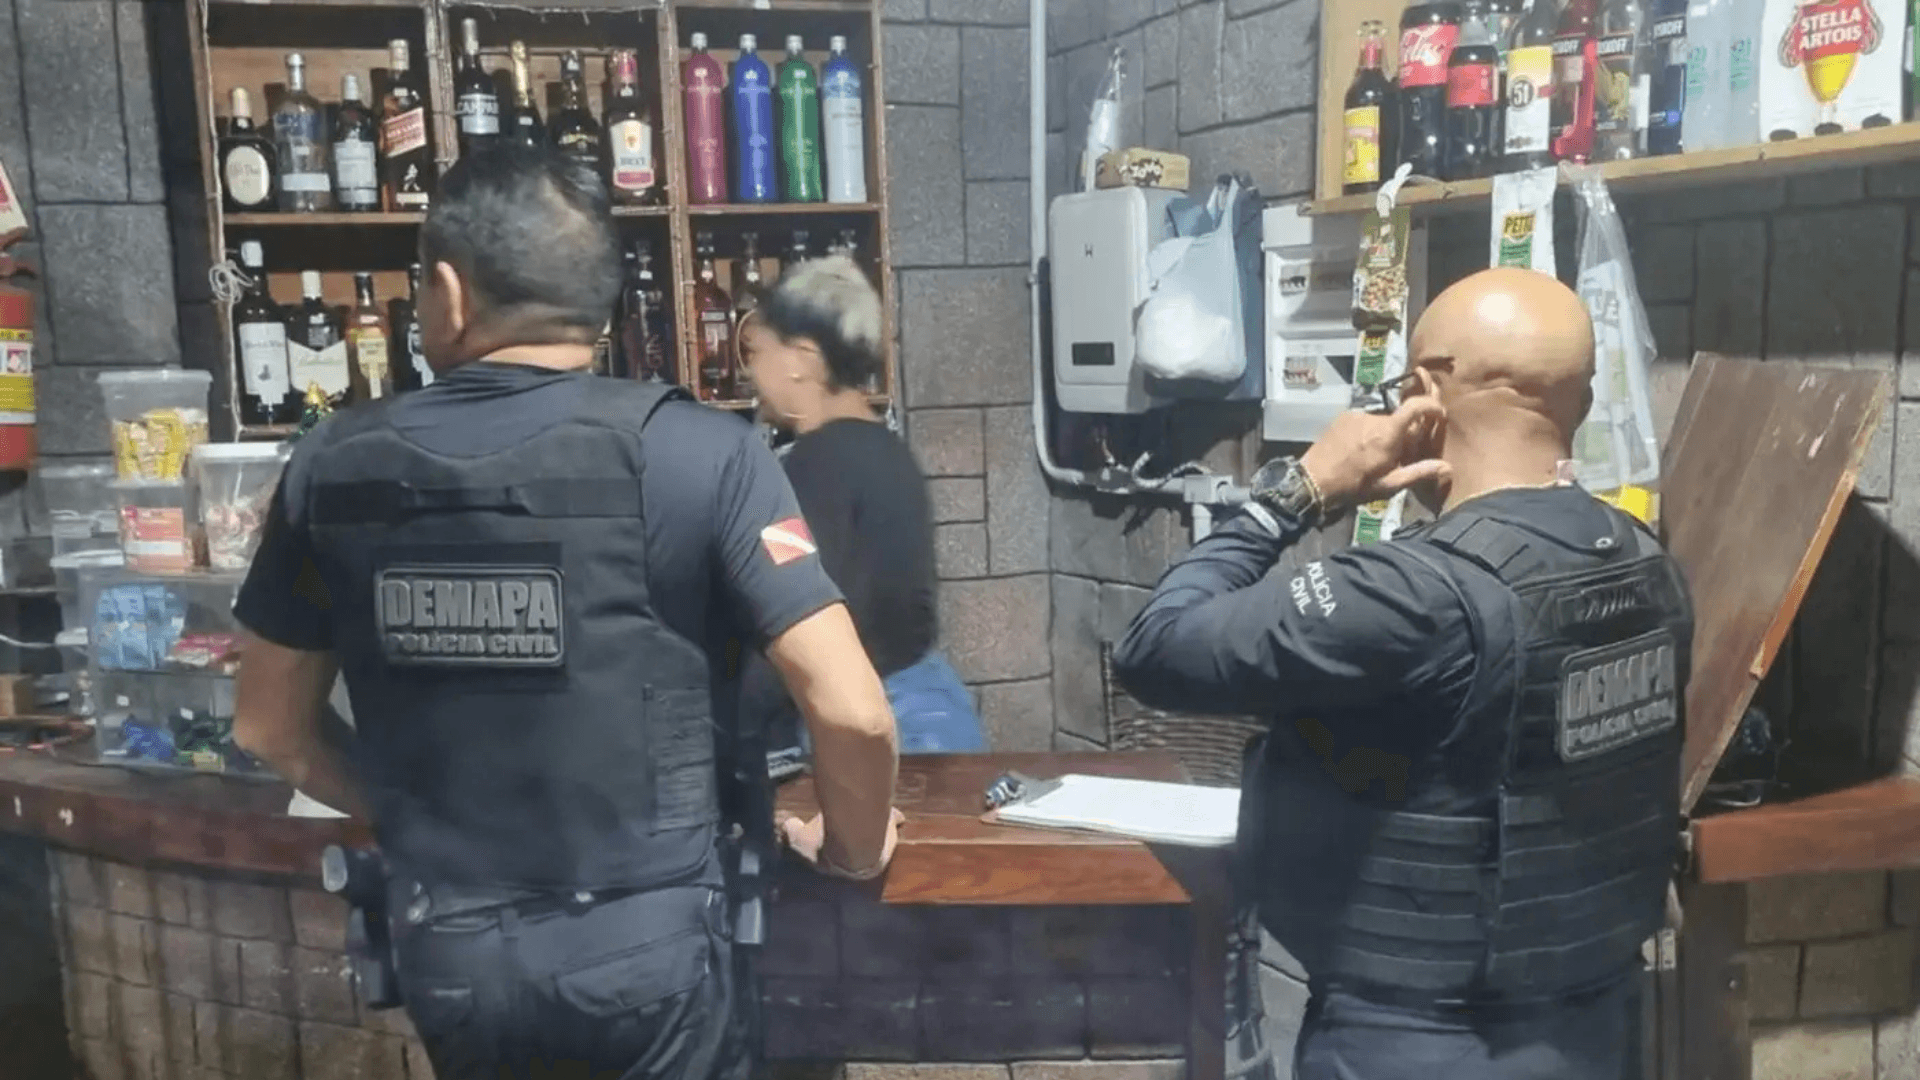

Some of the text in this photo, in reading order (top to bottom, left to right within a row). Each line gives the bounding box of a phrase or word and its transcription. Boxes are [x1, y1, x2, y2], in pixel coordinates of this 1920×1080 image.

[1801, 7, 1861, 32] STELLA
[1799, 25, 1861, 49] ARTOIS
[1512, 83, 1530, 107] 51
[383, 579, 559, 628] DEMAPA
[1290, 576, 1312, 616] CIVIL
[486, 634, 559, 654] CIVIL
[1566, 645, 1676, 721] DEMAPA
